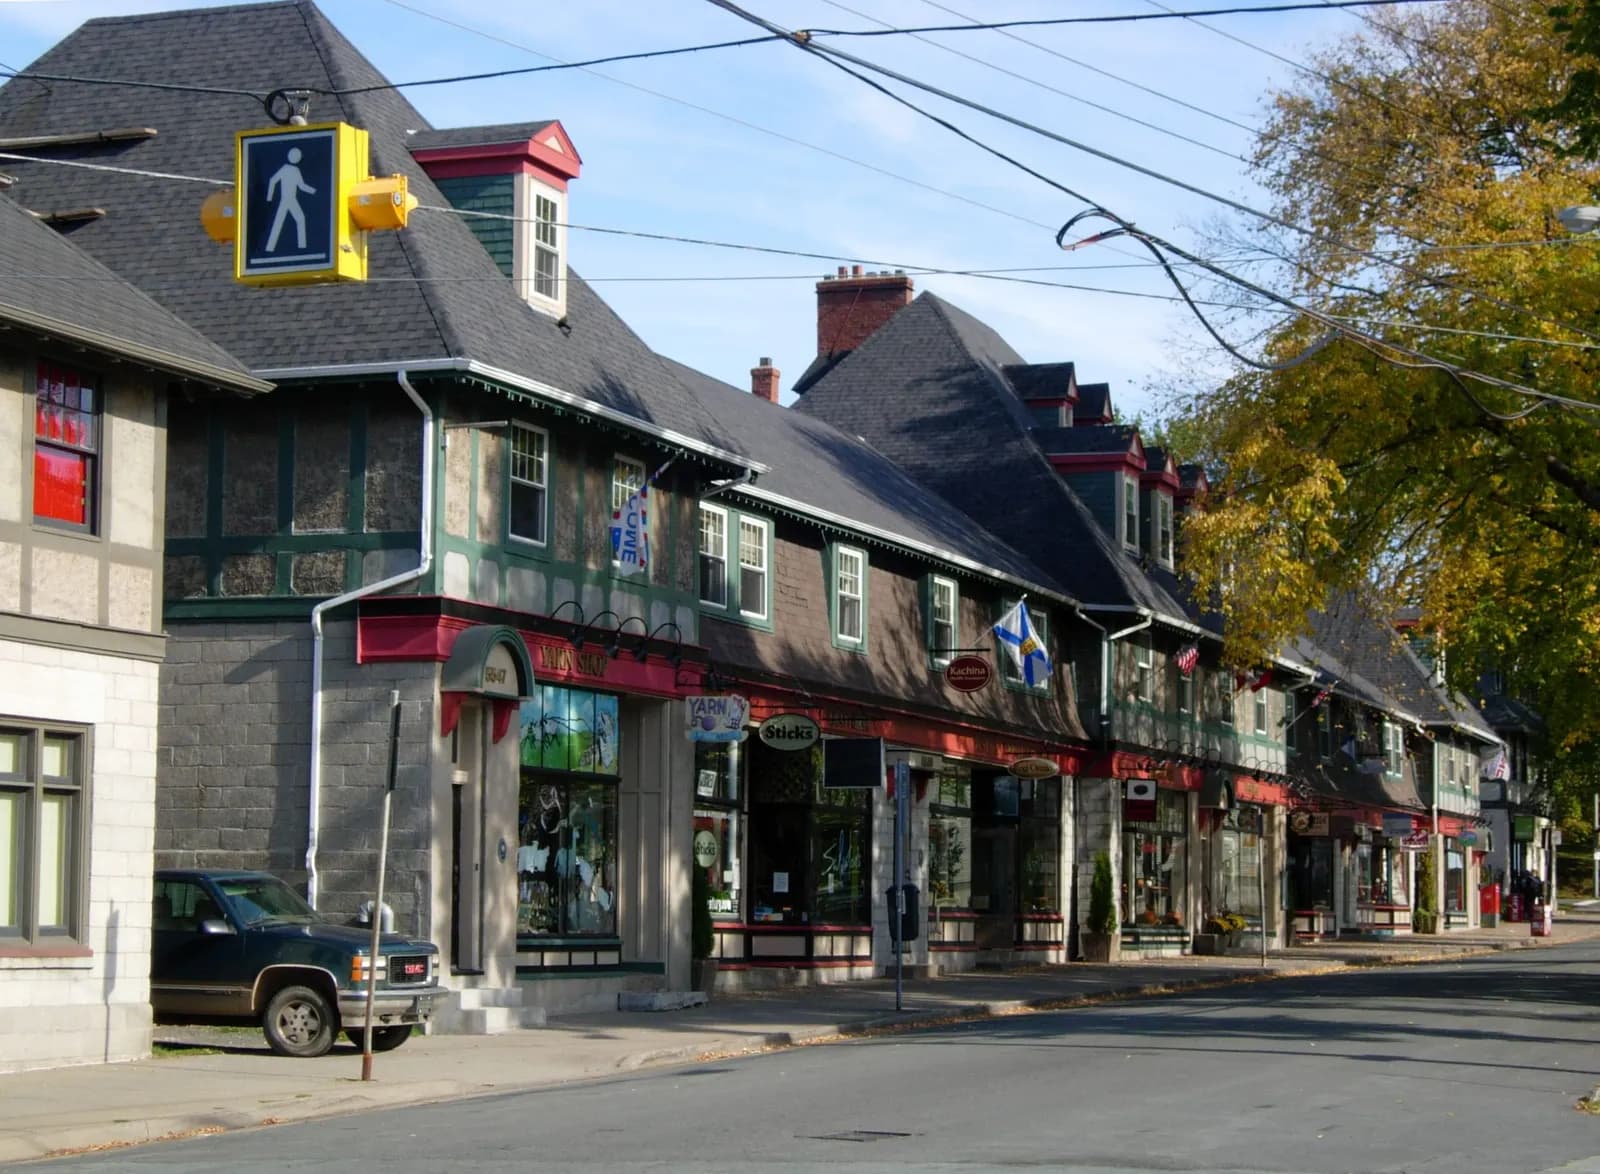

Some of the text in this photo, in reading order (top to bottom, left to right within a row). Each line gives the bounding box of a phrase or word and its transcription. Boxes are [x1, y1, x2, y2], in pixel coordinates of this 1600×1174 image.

[540, 646, 608, 677] YARN SHOP
[950, 665, 986, 676] Kachina
[688, 698, 727, 715] YARN
[766, 724, 813, 739] Sticks
